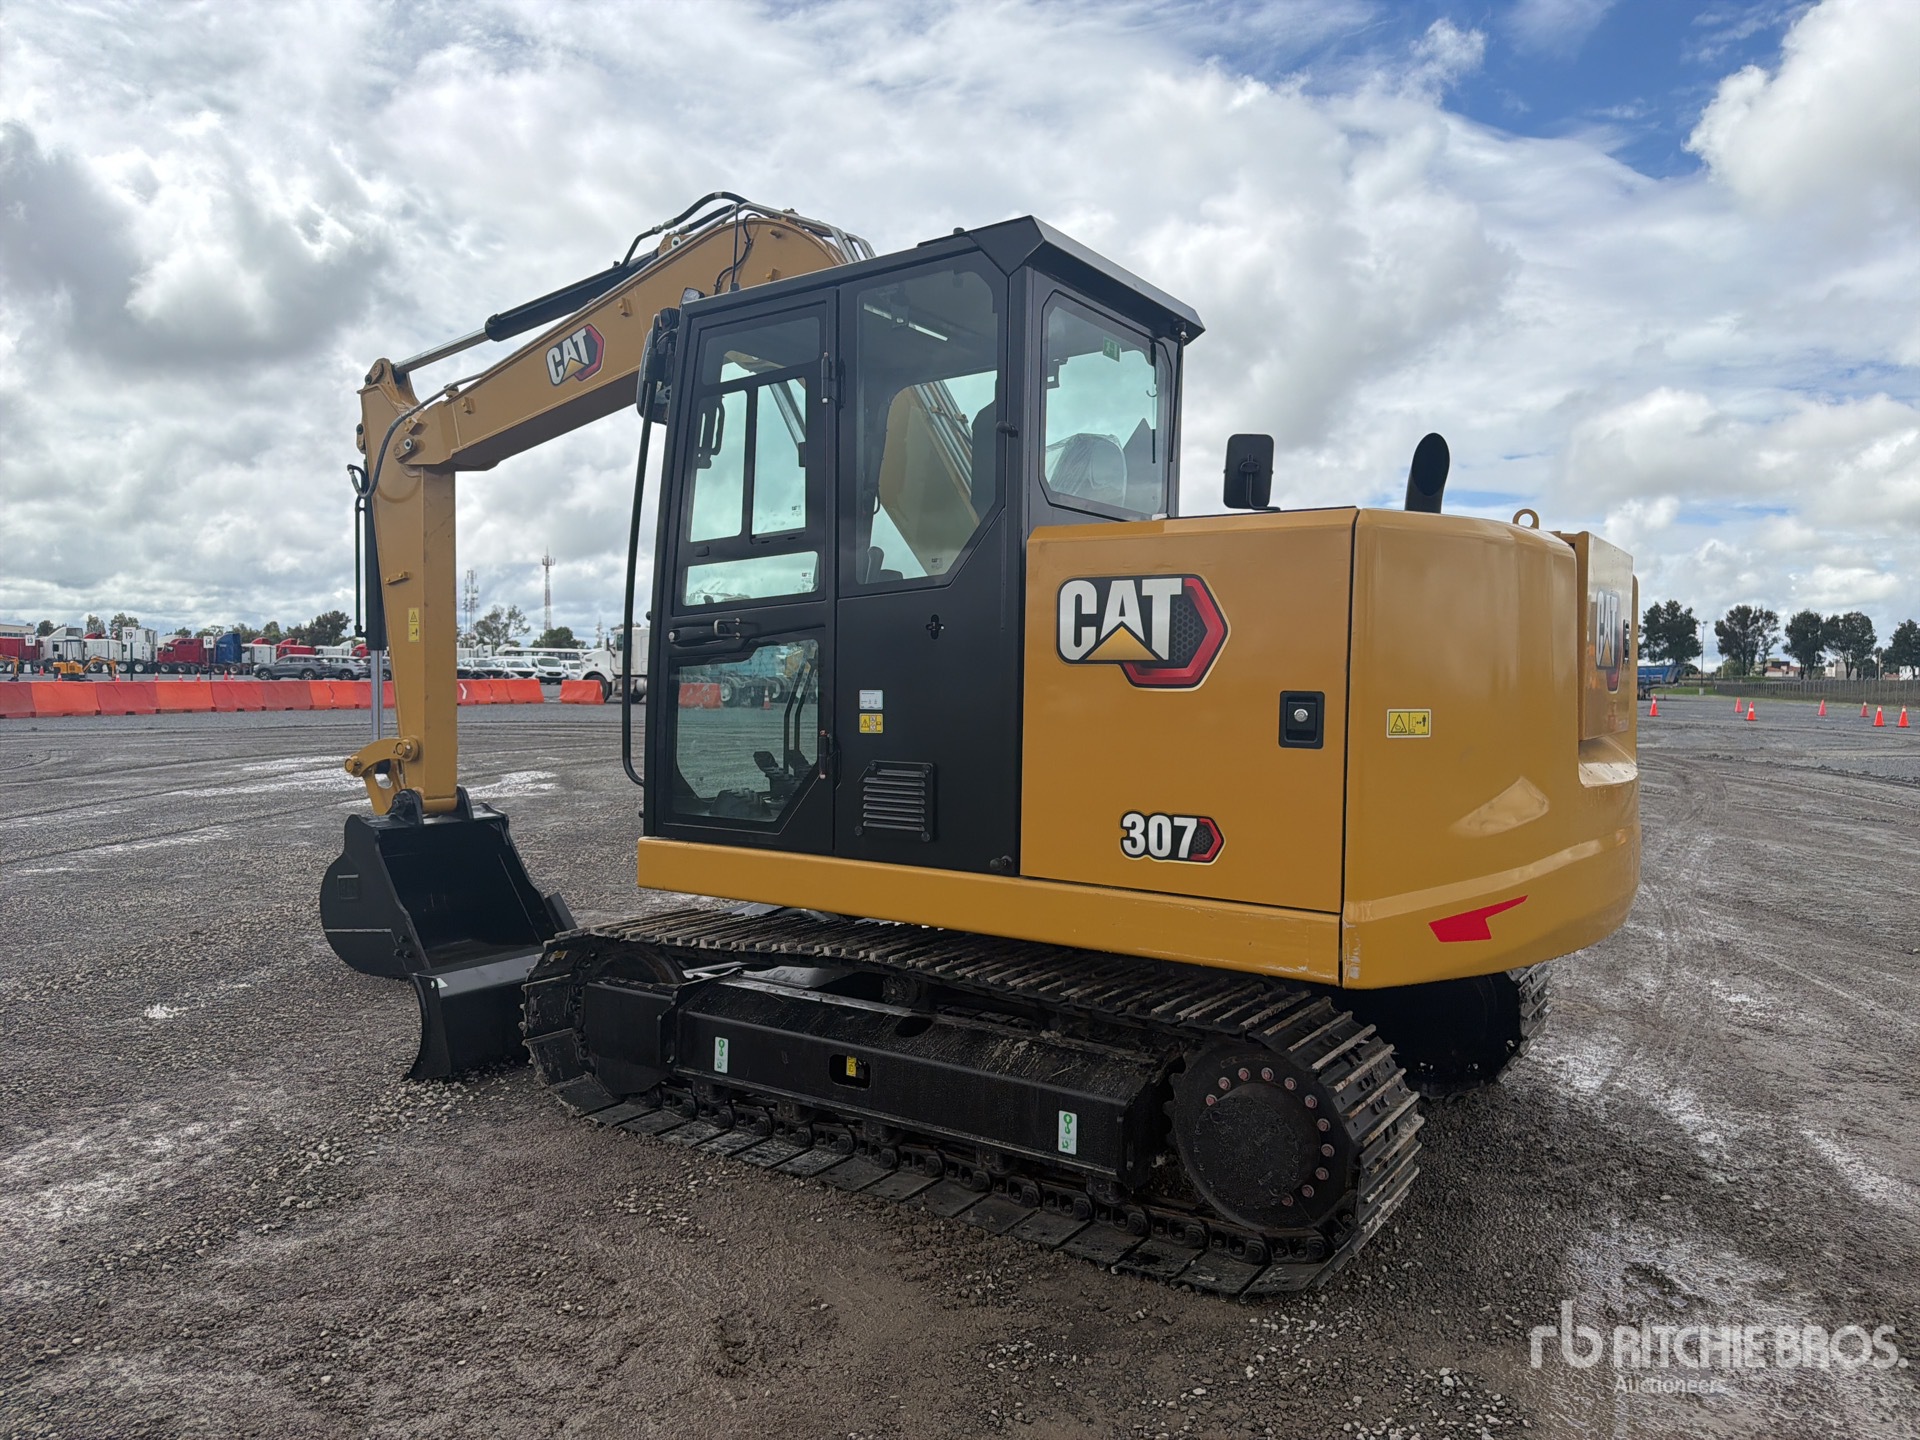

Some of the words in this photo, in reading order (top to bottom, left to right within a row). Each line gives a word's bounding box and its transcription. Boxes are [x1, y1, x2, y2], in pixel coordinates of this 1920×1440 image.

[547, 329, 589, 385] CAT
[1058, 577, 1183, 661] CAT
[1596, 590, 1618, 667] CAT
[1122, 813, 1199, 860] 307
